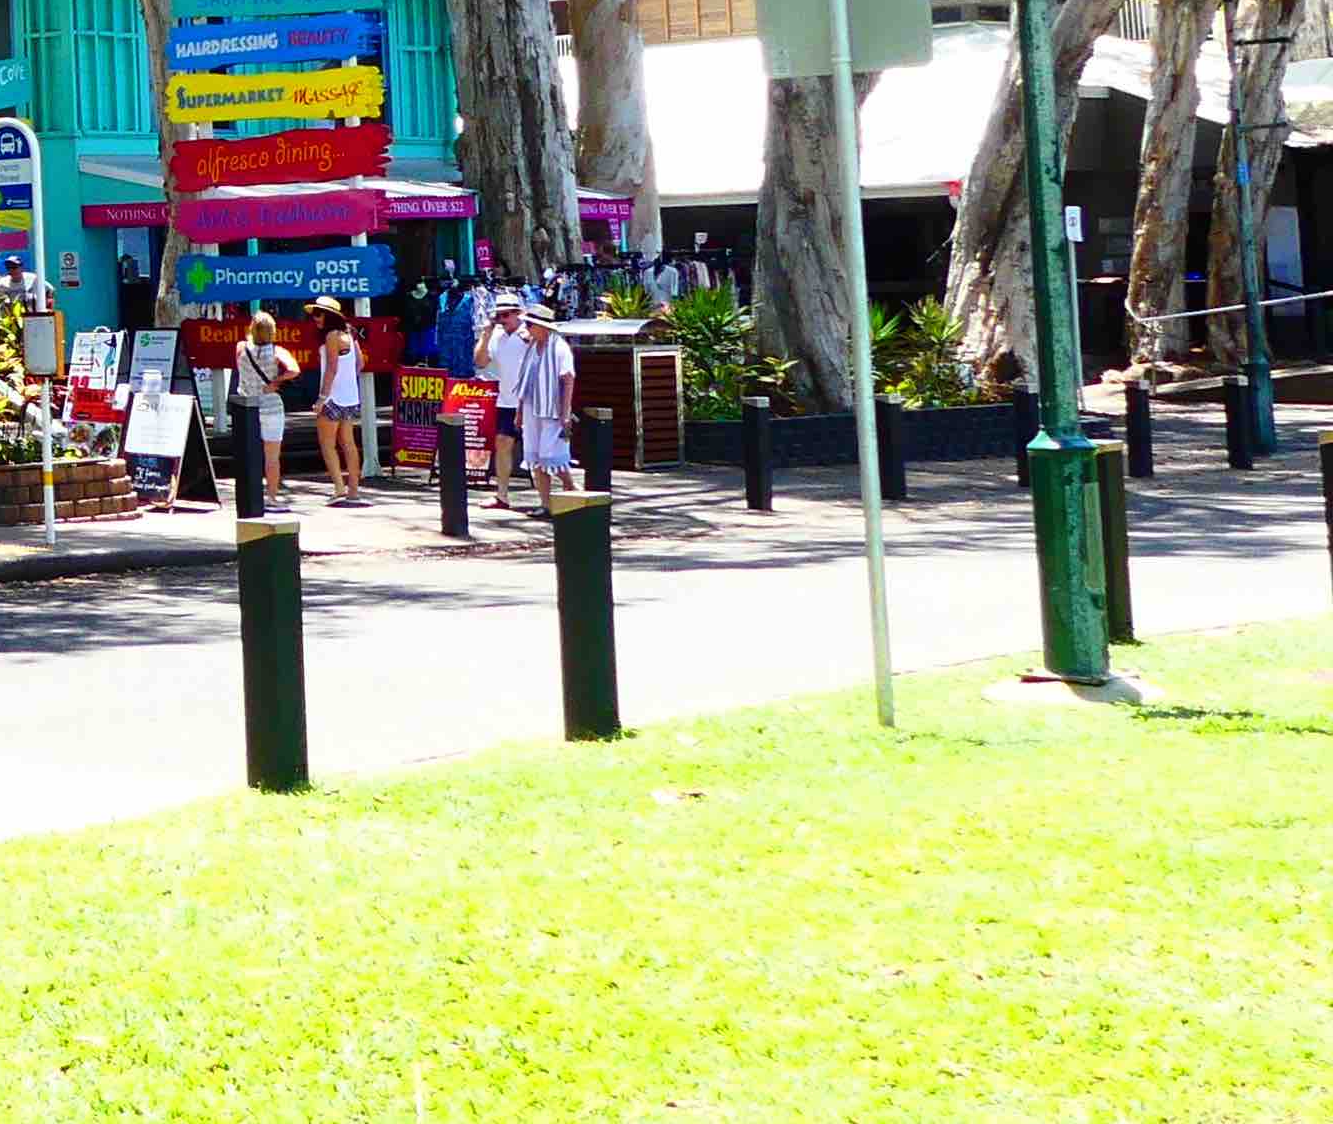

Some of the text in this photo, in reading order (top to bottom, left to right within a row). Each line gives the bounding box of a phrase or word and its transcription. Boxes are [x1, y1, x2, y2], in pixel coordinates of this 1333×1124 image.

[175, 33, 279, 59] HAIRDRESSING
[177, 85, 285, 109] SUPERMARKET
[196, 145, 270, 181] alfresco
[107, 208, 157, 221] NOTHING
[315, 259, 361, 275] POST
[215, 268, 304, 287] Pharmacy
[309, 277, 369, 294] OFFICE
[200, 324, 239, 343] Real
[400, 376, 445, 400] SUPER
